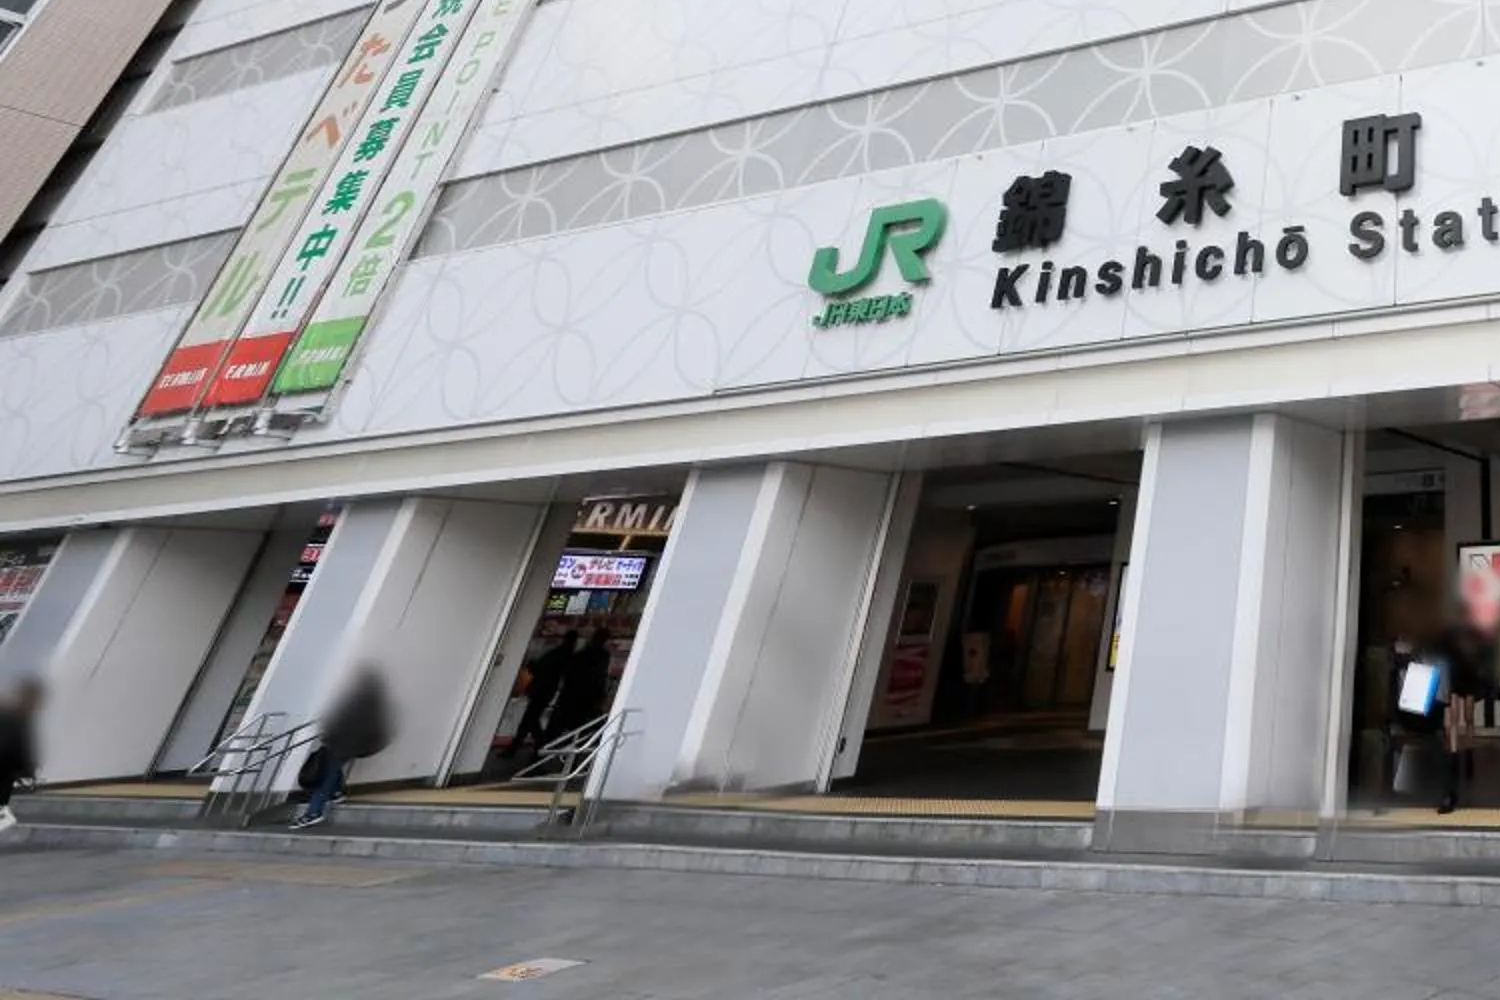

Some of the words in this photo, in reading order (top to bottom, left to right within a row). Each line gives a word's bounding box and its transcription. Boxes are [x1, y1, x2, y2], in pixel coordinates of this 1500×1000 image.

[808, 198, 949, 296] JR
[991, 225, 1309, 310] Kinshichō
[576, 501, 680, 530] RMI
